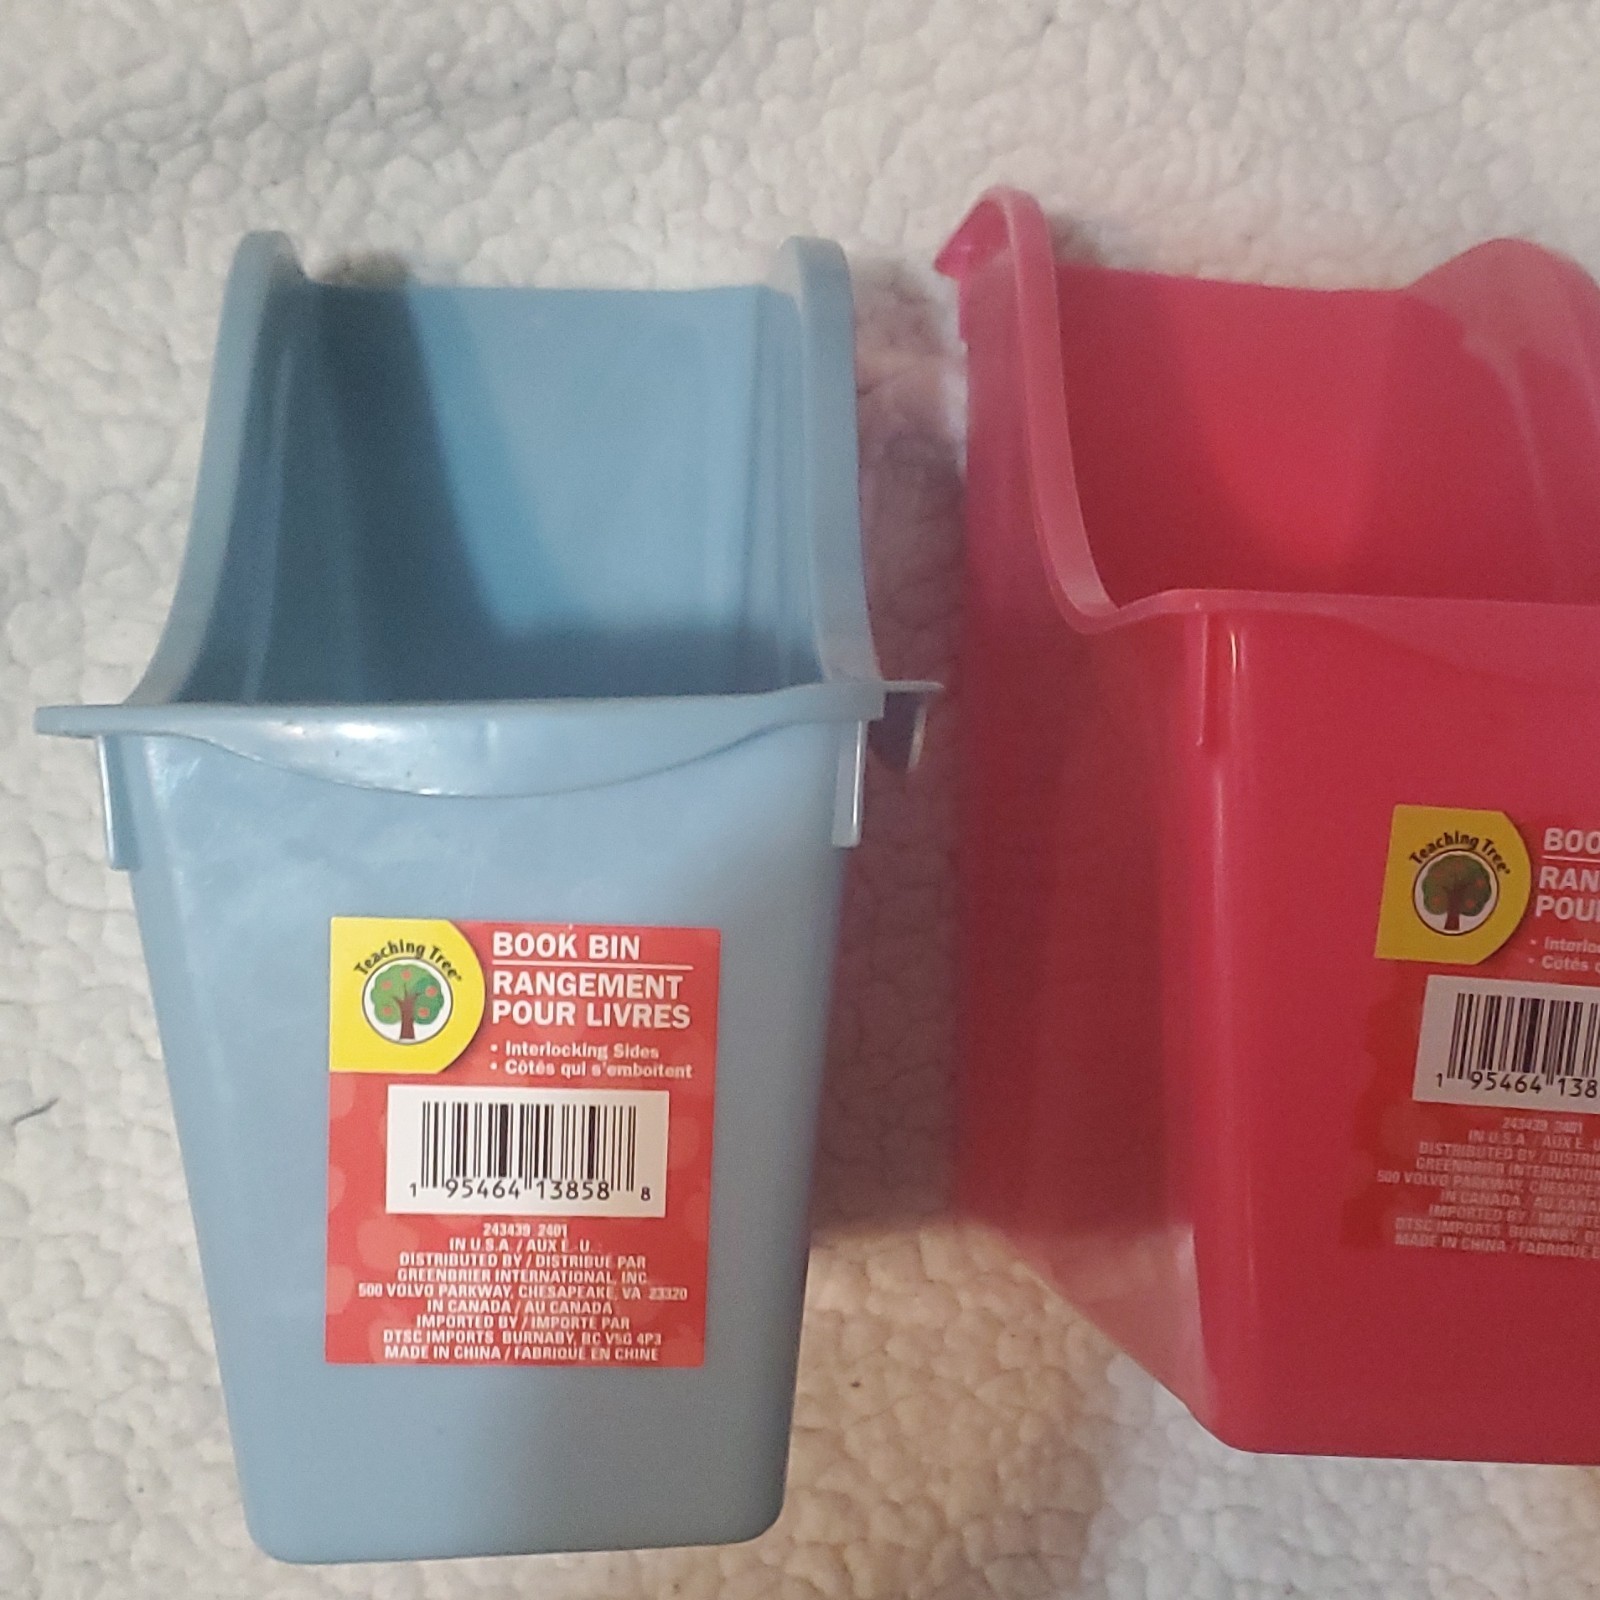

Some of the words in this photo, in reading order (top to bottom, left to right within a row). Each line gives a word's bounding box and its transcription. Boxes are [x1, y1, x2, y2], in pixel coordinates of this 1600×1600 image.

[1408, 830, 1480, 865] Teaching
[1543, 827, 1600, 855] BOO
[1538, 865, 1600, 893] RAN
[492, 931, 578, 959] BOOK
[588, 934, 640, 960] BIN
[354, 939, 426, 976] Teaching
[492, 970, 684, 1000] RANGEMENT
[491, 1000, 576, 1026] POUR
[586, 1002, 691, 1029] LIVRES
[505, 1040, 608, 1061] Interlocking
[613, 1043, 659, 1060] Sides
[561, 1060, 586, 1079] qui
[1470, 1070, 1542, 1095] 95464
[1557, 1077, 1600, 1099] 138
[1418, 1141, 1514, 1160] DISTRIBUTED
[1541, 1134, 1571, 1149] AUX
[444, 1178, 521, 1200] 95464
[536, 1180, 610, 1201] 13858
[640, 1186, 652, 1202] 8
[1460, 1190, 1521, 1207] CANADA
[1558, 1197, 1600, 1213] CANA
[482, 1222, 531, 1237] 243439
[537, 1222, 568, 1238] 2401
[449, 1237, 467, 1252] IN
[526, 1238, 557, 1253] AUX
[399, 1251, 498, 1267] DISTRIBUTED
[502, 1253, 522, 1268] BY
[617, 1255, 646, 1270] PAR
[397, 1267, 491, 1282] GREENBRIER
[358, 1282, 383, 1298] 500
[386, 1283, 434, 1298] VOLVO
[621, 1286, 642, 1300] VA
[648, 1287, 688, 1301] 23320
[427, 1298, 443, 1313] IN
[447, 1299, 511, 1314] CANADA
[524, 1300, 546, 1315] AU
[549, 1301, 613, 1315] CANADA
[416, 1314, 494, 1329] IMPORTED
[498, 1315, 518, 1330] BY
[601, 1316, 631, 1331] PAR
[383, 1329, 422, 1344] DTSC
[581, 1332, 601, 1346] BC
[636, 1333, 662, 1347] 4P3
[384, 1344, 429, 1360] MADE
[433, 1345, 450, 1360] IN
[453, 1345, 502, 1360] CHINA
[590, 1347, 611, 1361] EN
[614, 1347, 659, 1362] CHINE
